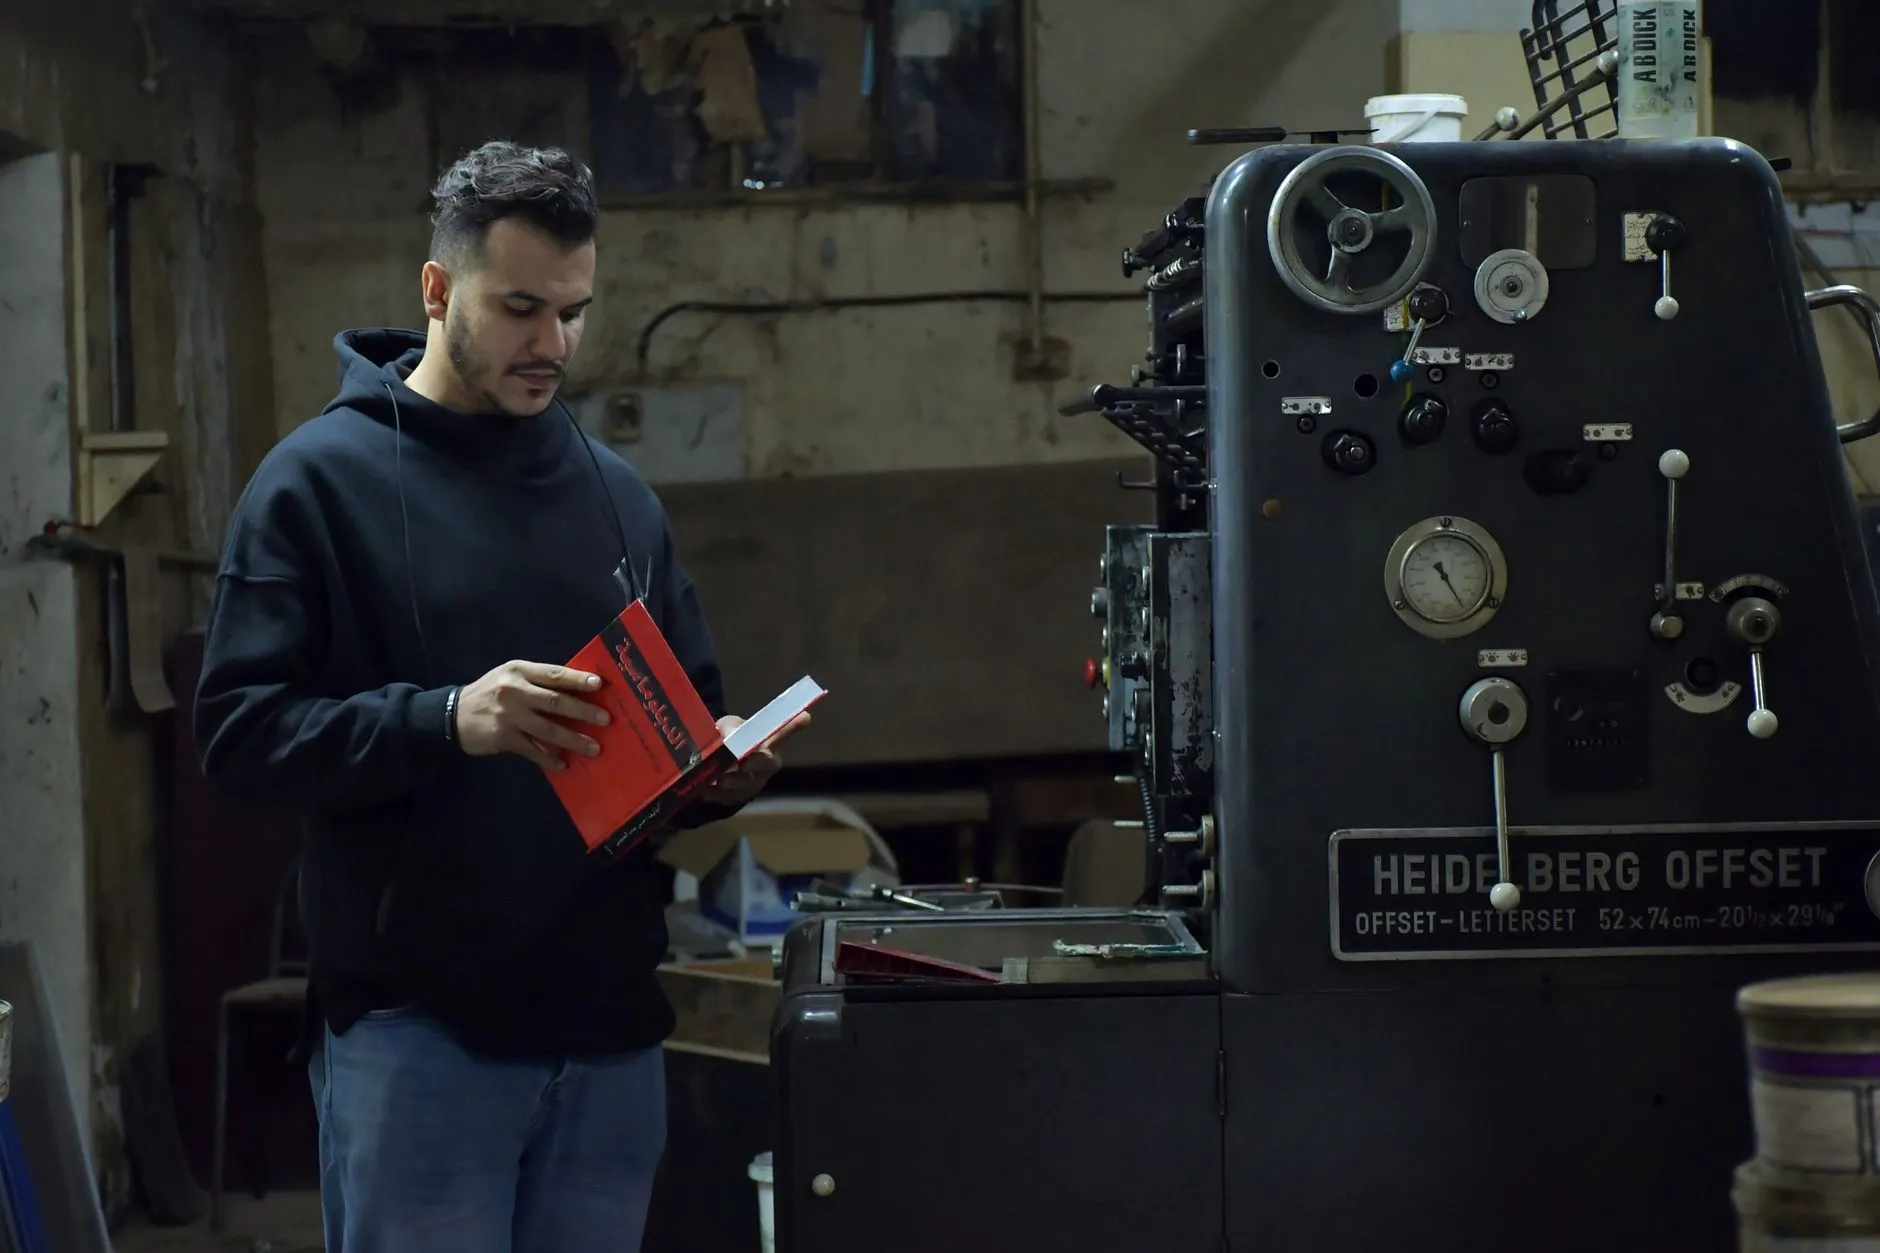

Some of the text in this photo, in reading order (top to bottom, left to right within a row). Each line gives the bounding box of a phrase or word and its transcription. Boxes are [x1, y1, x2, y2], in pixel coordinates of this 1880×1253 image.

[1633, 8, 1656, 51] DICK
[1373, 847, 1828, 896] HEIDEBERG OFFSET
